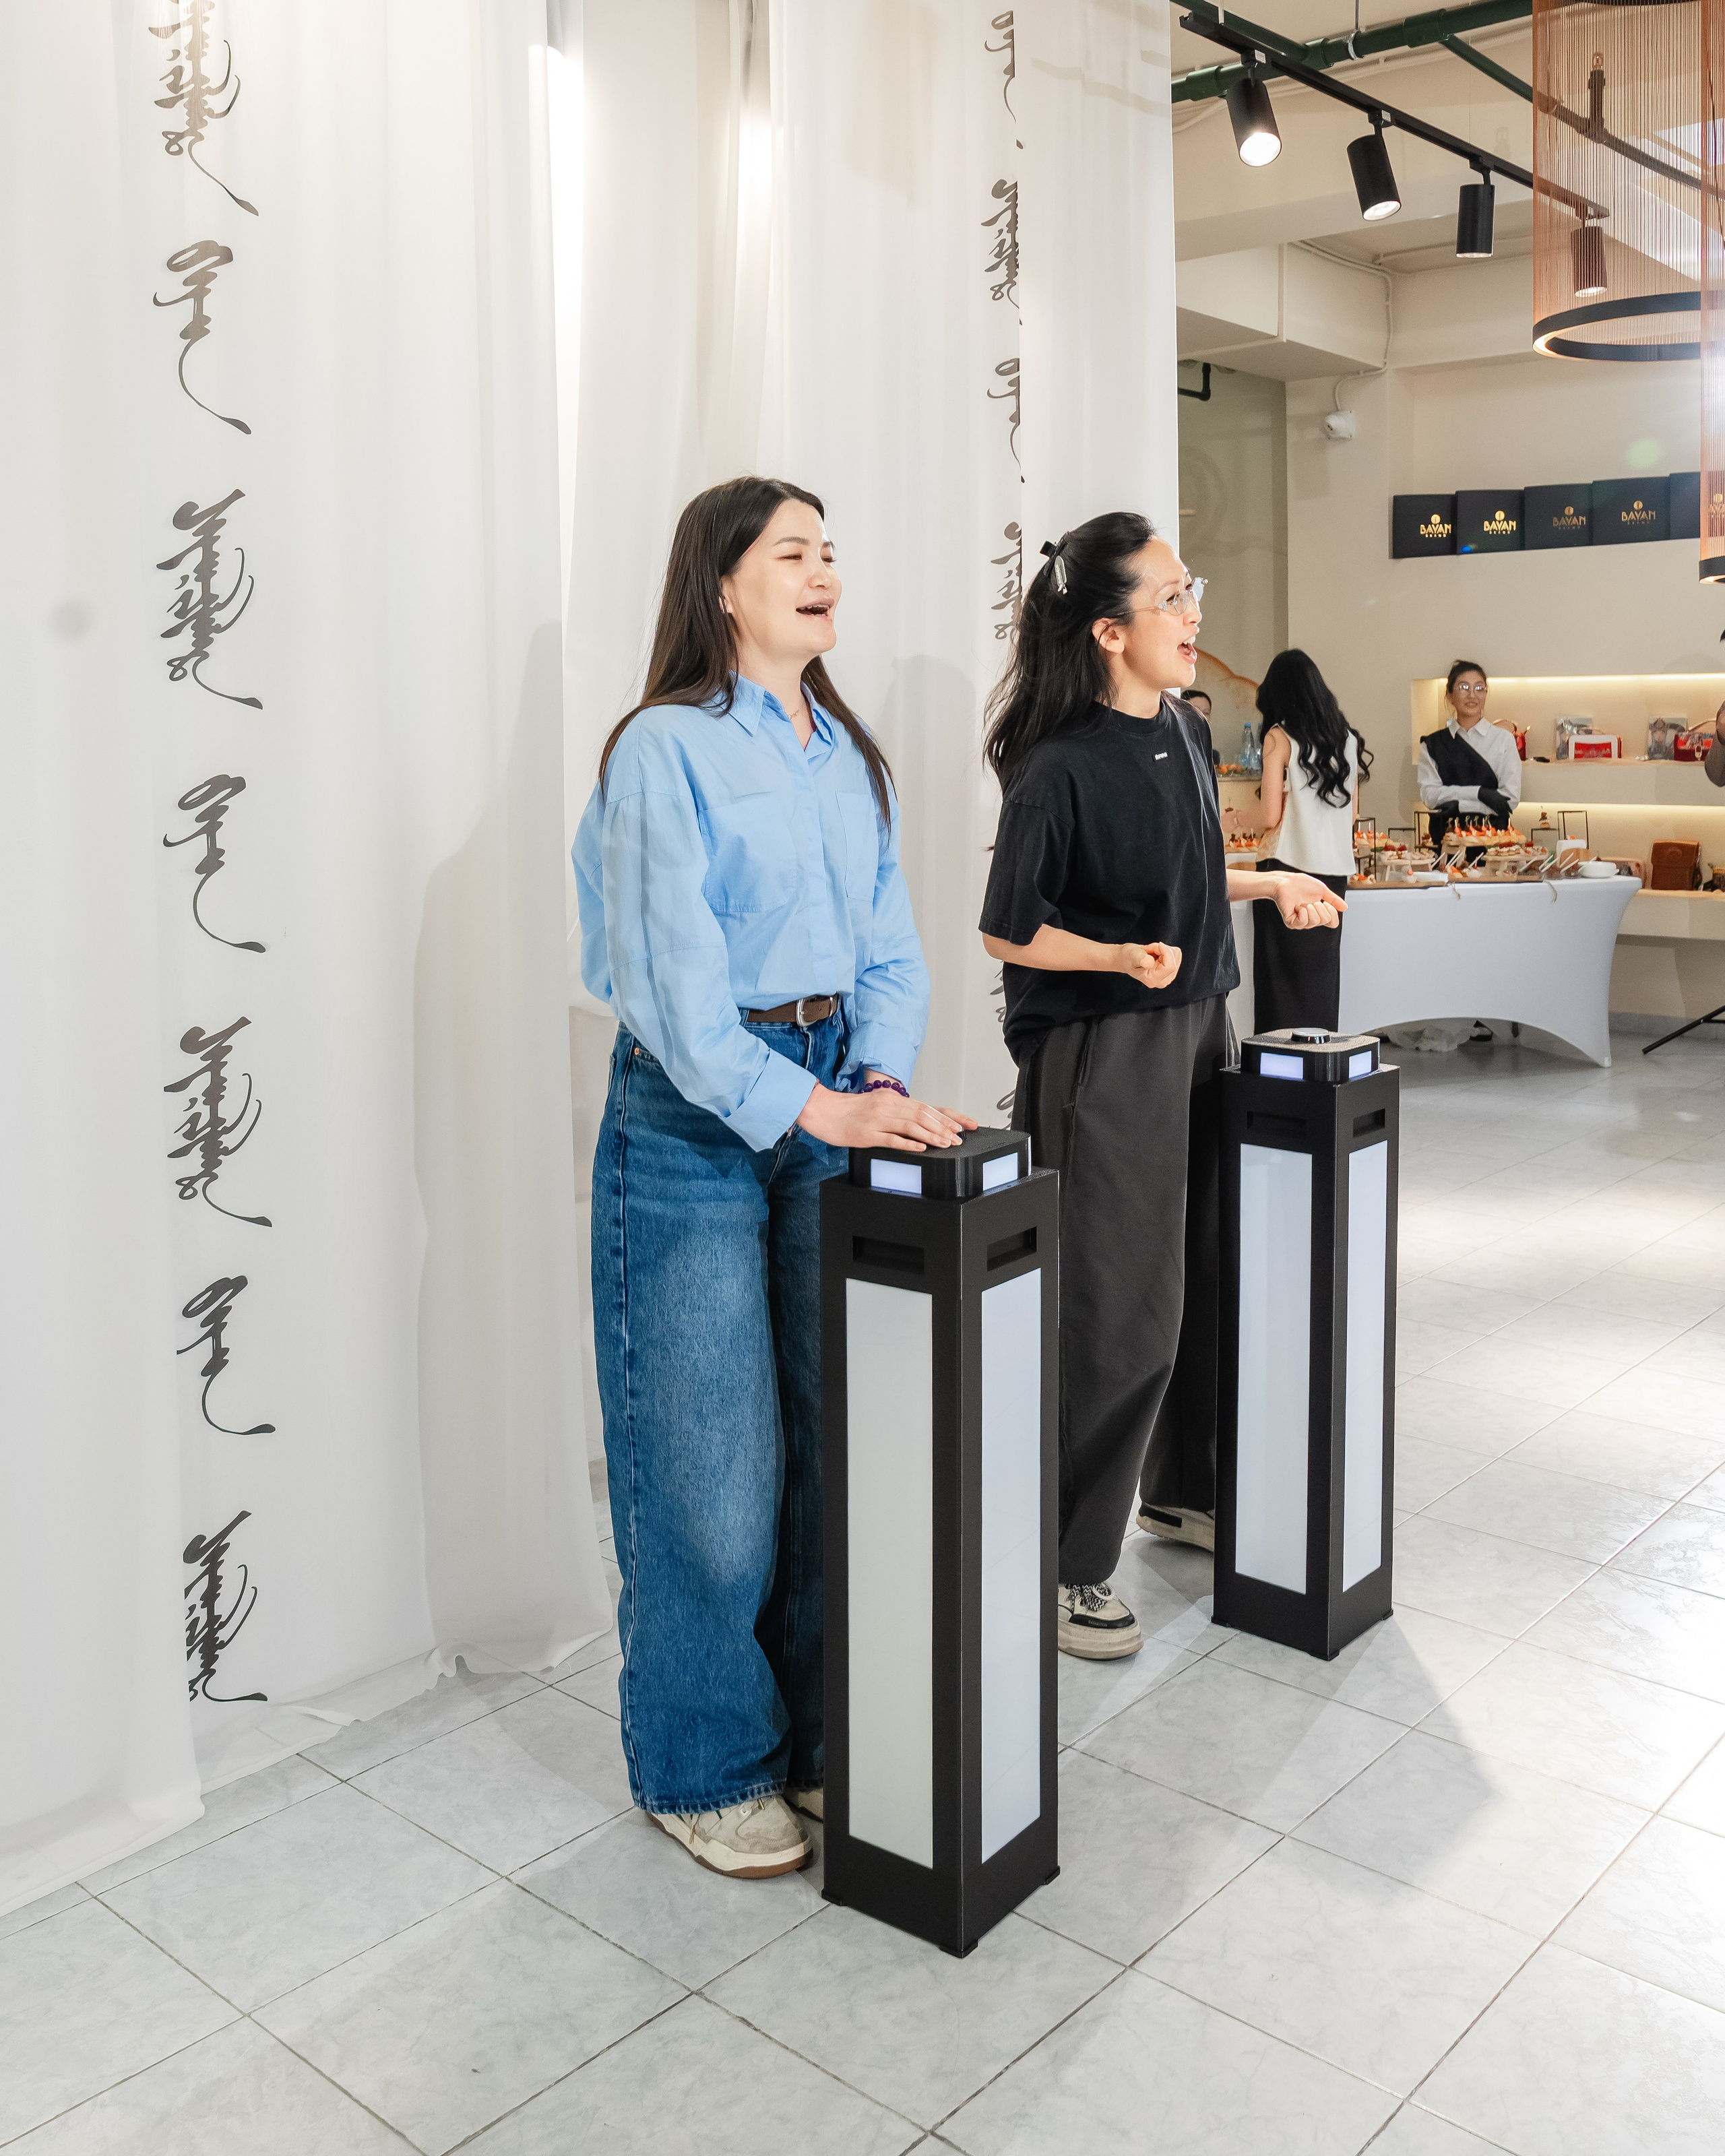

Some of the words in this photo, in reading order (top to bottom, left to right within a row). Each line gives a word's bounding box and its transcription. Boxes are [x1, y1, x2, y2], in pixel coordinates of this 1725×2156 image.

[1552, 515, 1586, 527] BAYAN
[1621, 510, 1656, 521] BAYAN
[1420, 524, 1451, 534] BAYAN
[1484, 520, 1517, 532] BAYAN
